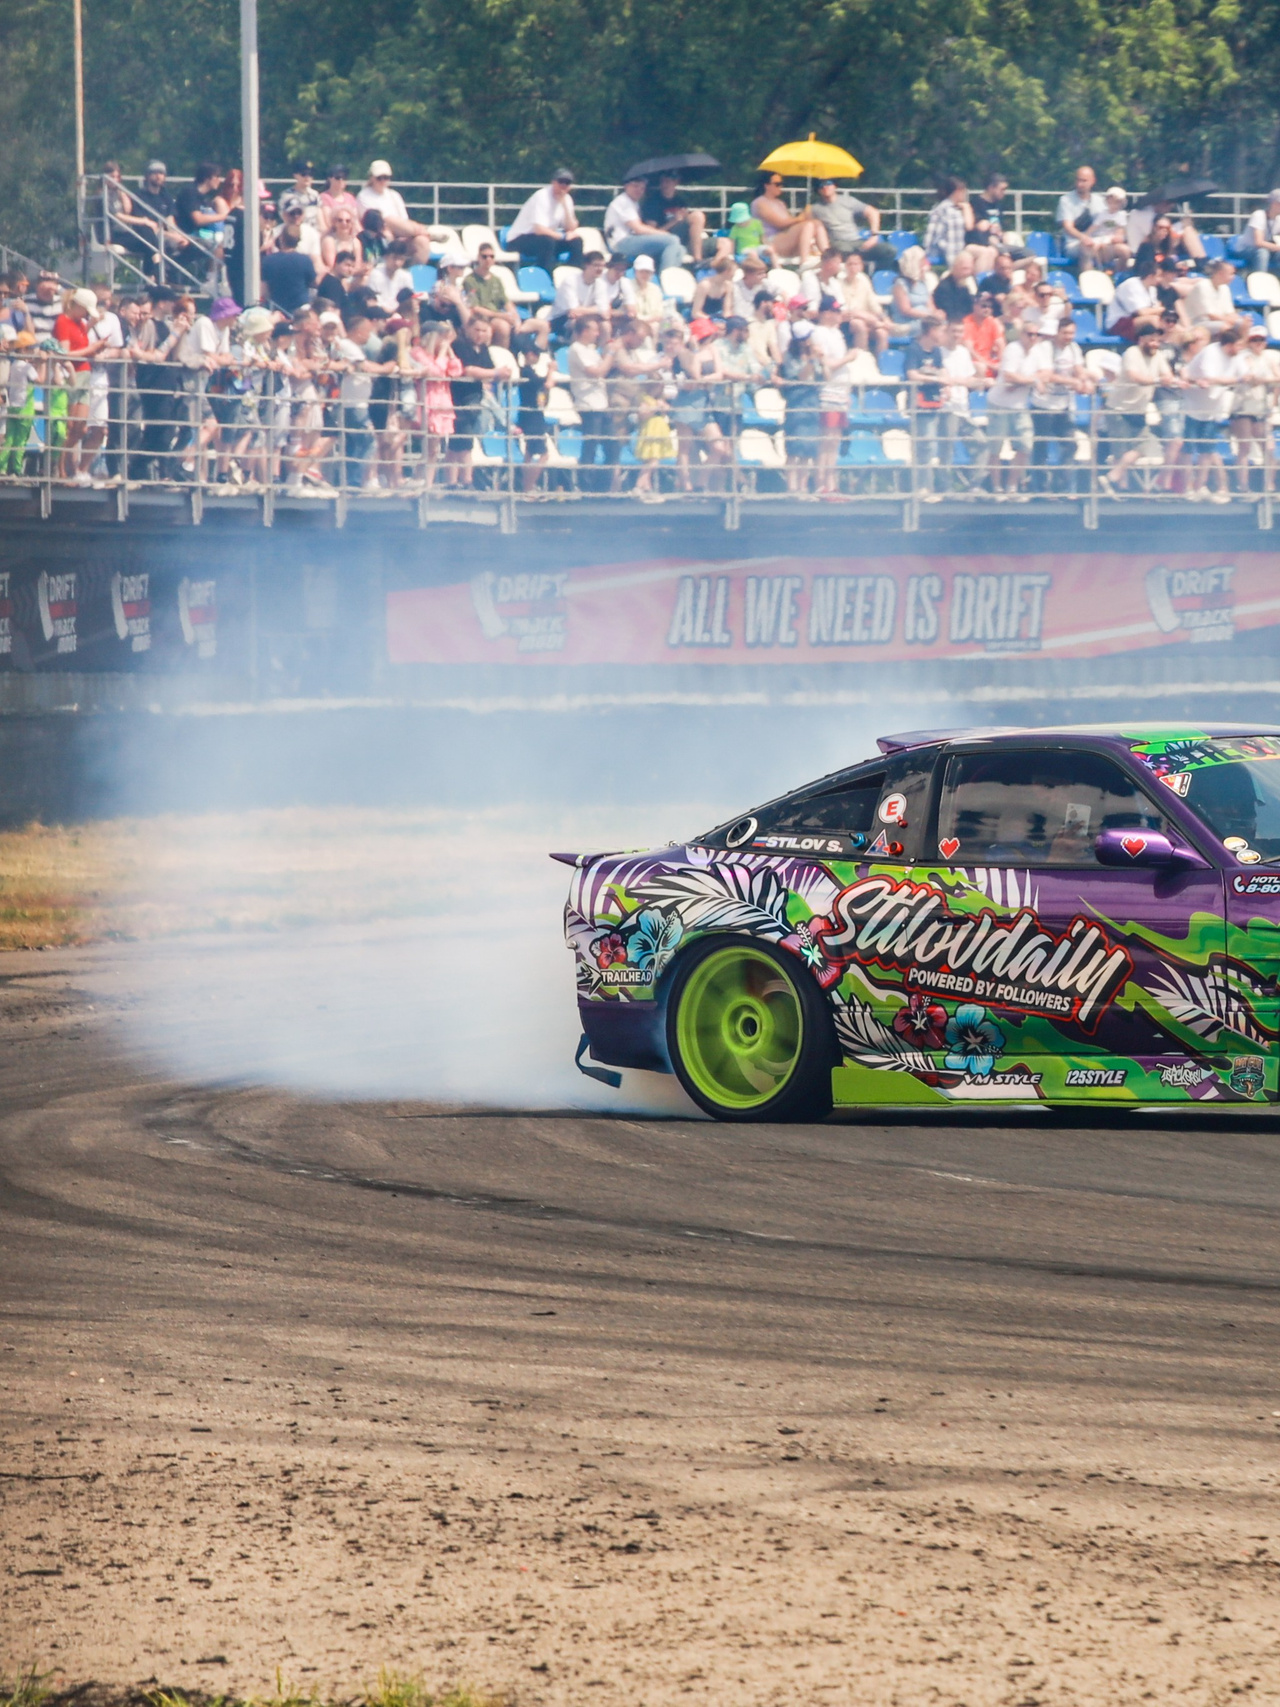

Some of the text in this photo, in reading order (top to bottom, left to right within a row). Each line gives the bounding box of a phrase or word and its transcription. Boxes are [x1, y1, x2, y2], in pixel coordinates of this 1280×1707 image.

[498, 573, 568, 601] DRIFT
[1172, 566, 1236, 595] DRIFT
[670, 574, 1050, 645] ALL WE NEED IS DRIFT
[886, 800, 900, 817] E
[765, 836, 844, 853] STILOV S.
[601, 971, 652, 983] TRAILHEAD
[908, 967, 1073, 1012] POWERED BY FOLLOWERS
[963, 1072, 1043, 1085] VM STYLE
[1065, 1070, 1126, 1086] 125STYLE
